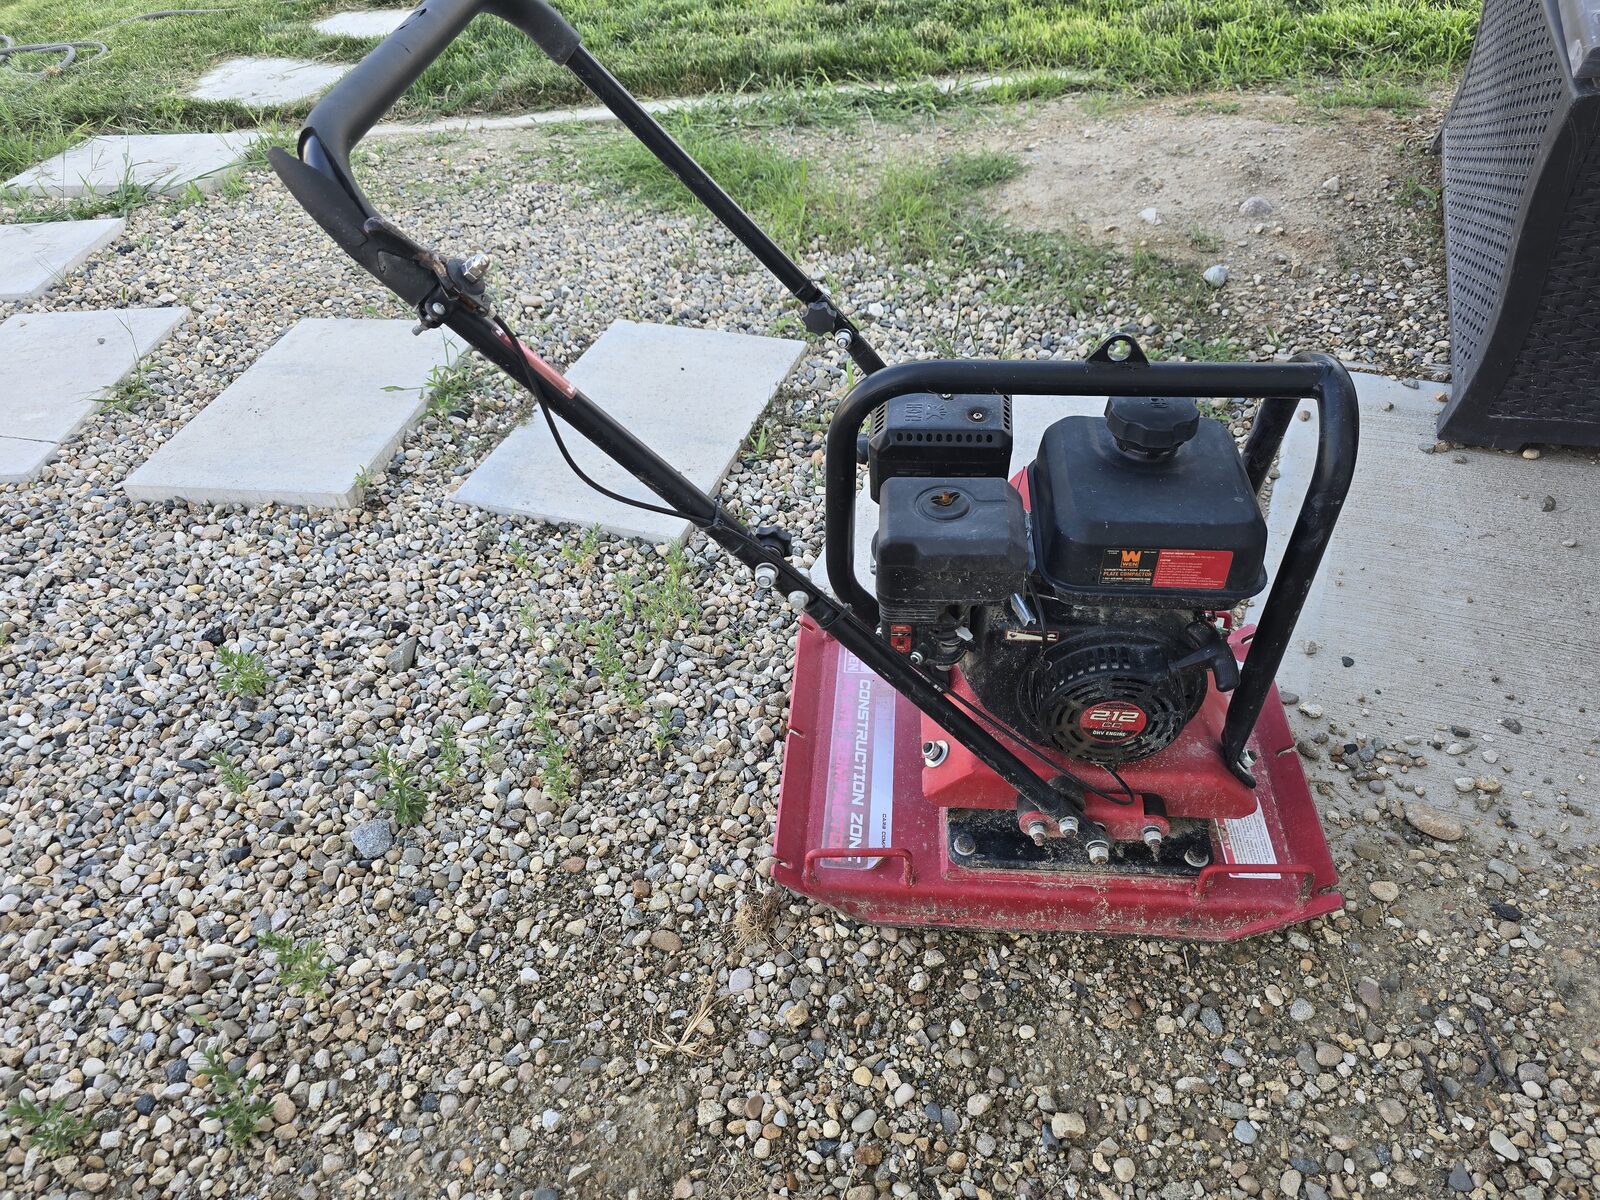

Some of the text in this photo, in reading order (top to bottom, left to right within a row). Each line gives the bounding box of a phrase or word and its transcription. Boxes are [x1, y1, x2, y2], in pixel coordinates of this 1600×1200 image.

[851, 679, 871, 806] CONSTRUCTION
[1089, 709, 1140, 723] 212
[828, 738, 851, 863] COMPACTO
